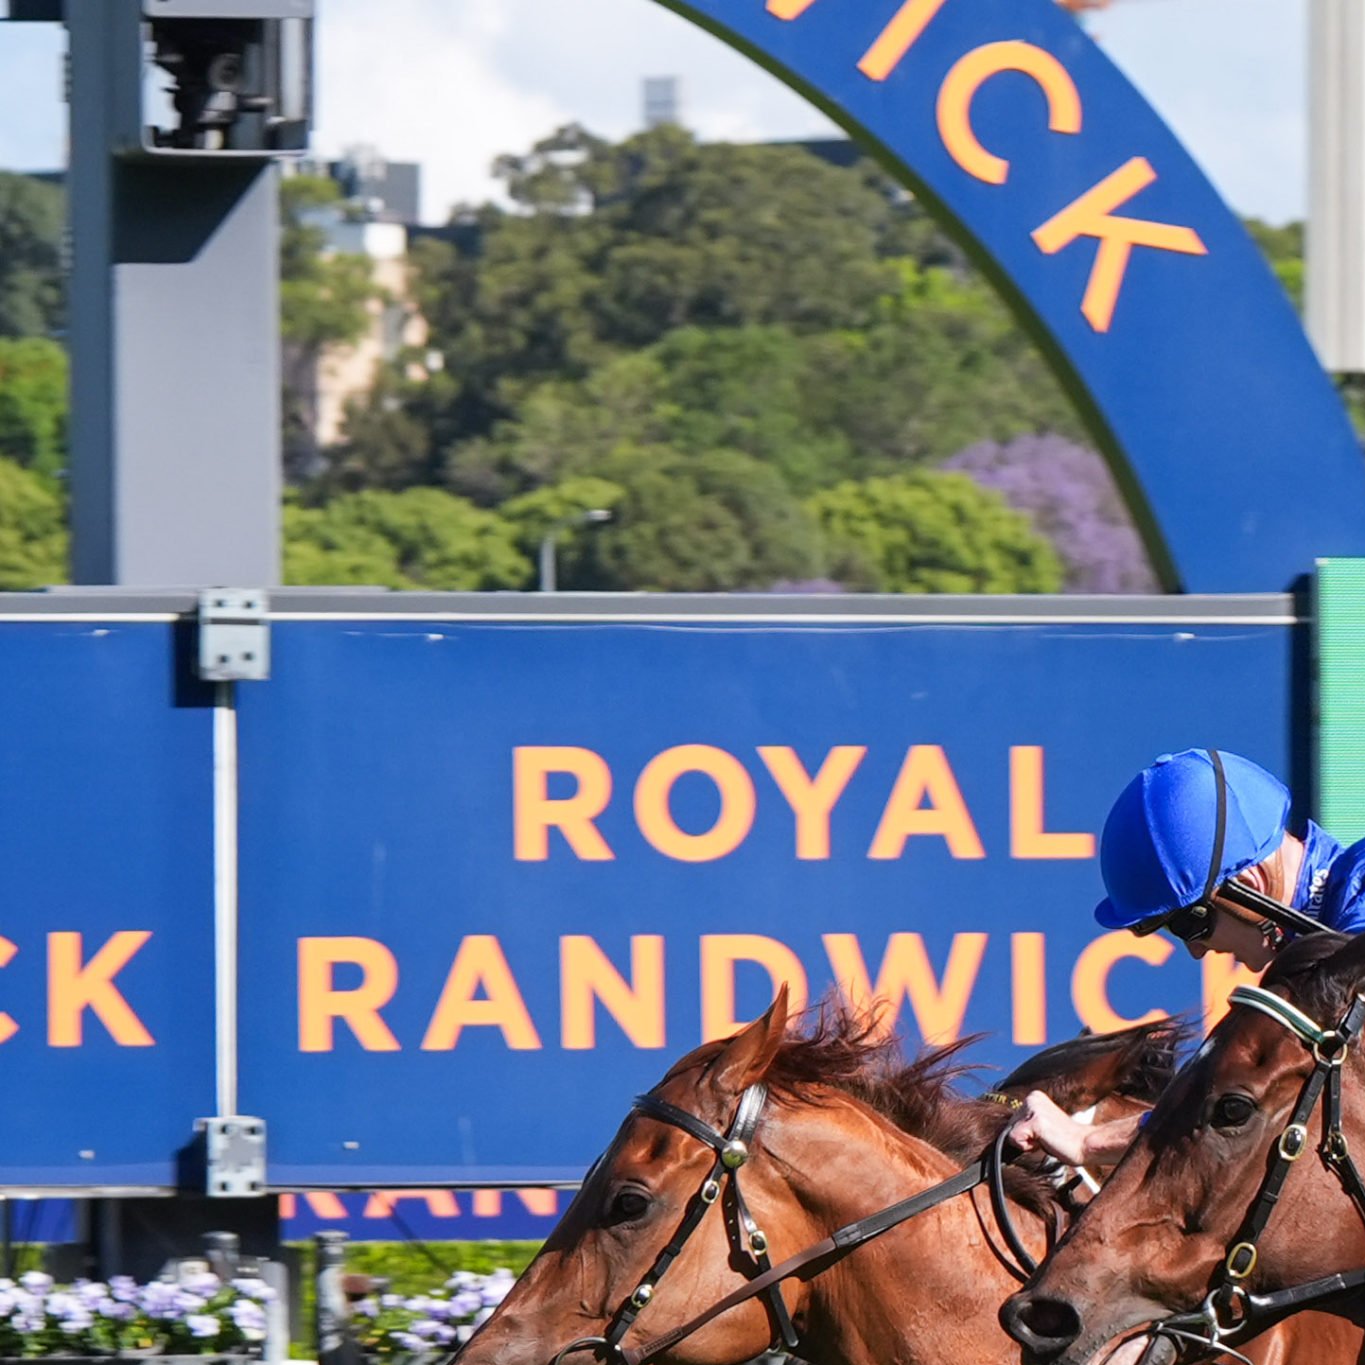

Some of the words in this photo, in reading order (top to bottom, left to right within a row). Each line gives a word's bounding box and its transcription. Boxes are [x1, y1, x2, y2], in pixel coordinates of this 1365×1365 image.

[765, 0, 1209, 333] ICK
[513, 743, 1096, 862] ROYAL
[0, 930, 157, 1047] K
